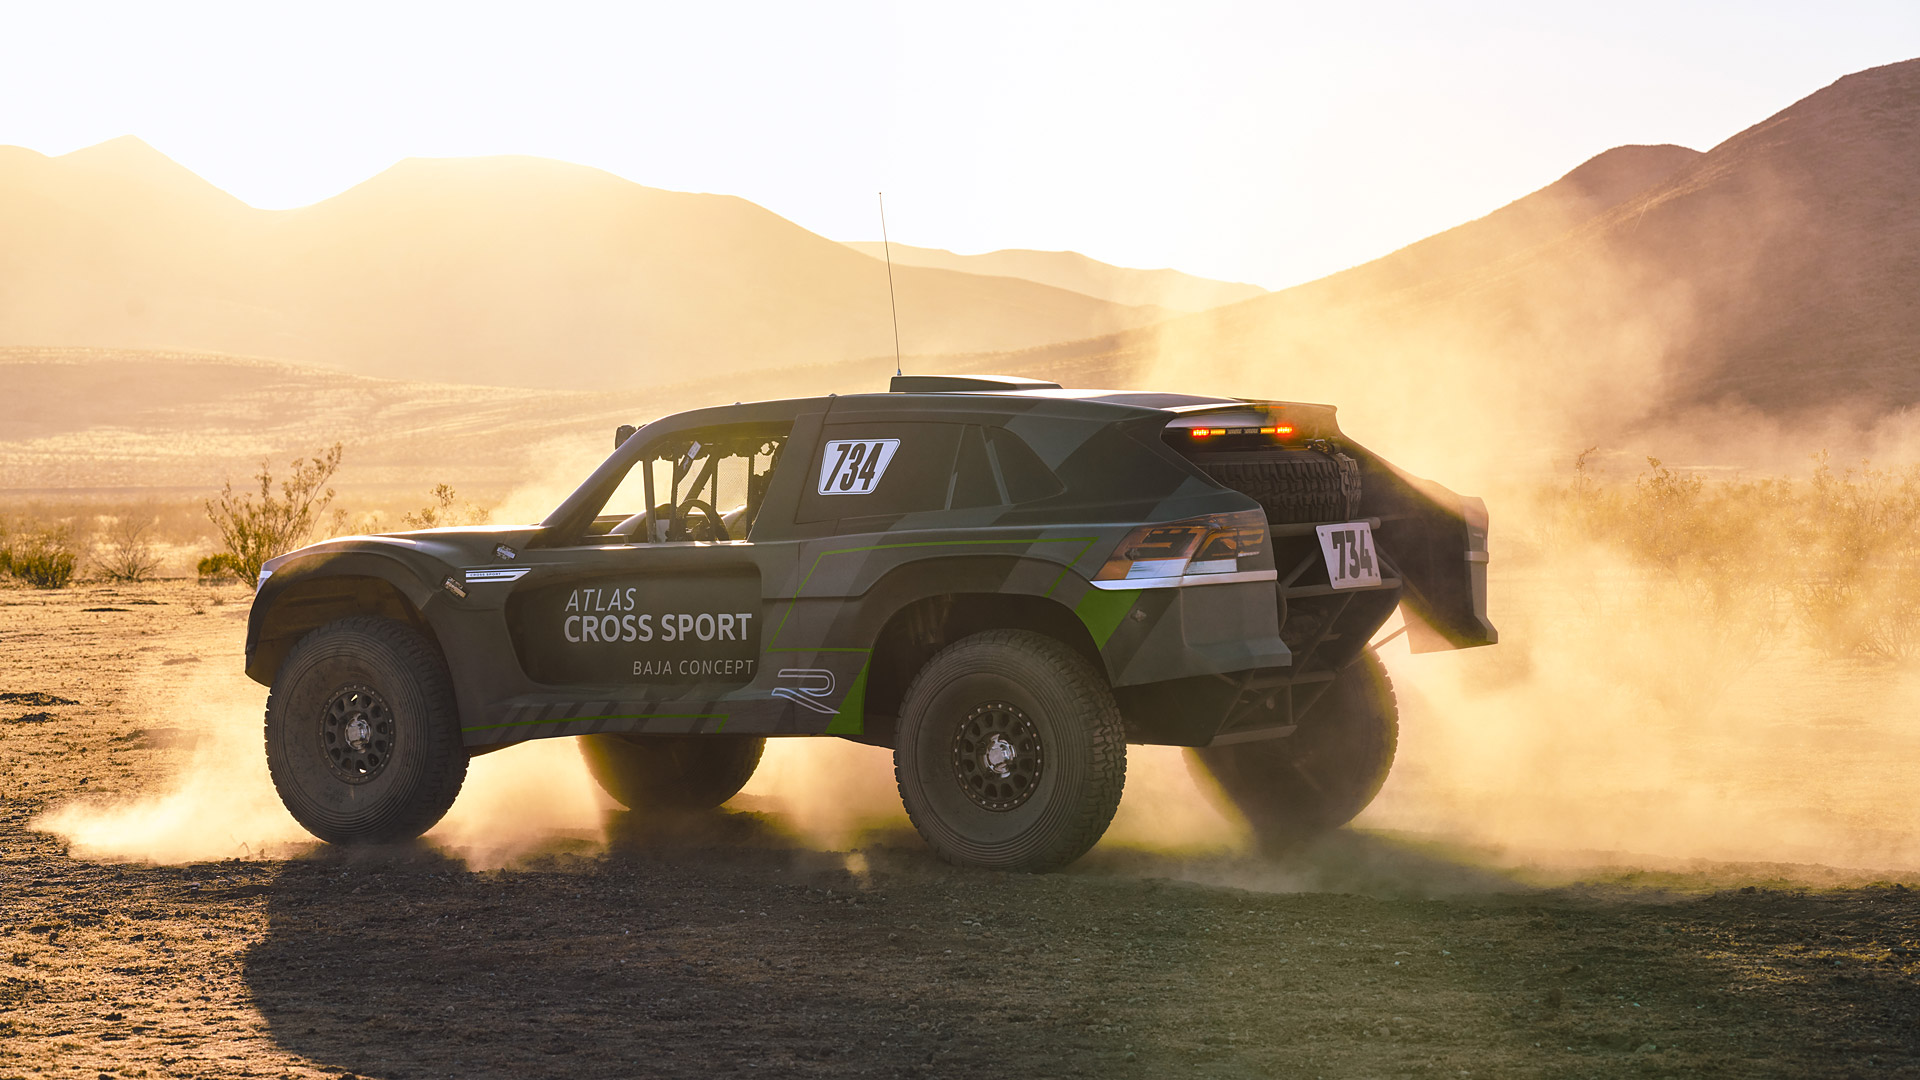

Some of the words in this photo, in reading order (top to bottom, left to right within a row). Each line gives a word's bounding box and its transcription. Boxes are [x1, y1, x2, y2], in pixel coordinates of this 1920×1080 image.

[823, 443, 884, 491] 734
[1331, 529, 1373, 579] 734
[564, 587, 637, 612] ATLAS
[564, 614, 653, 642] CROSS
[661, 613, 752, 642] SPORT
[633, 660, 672, 675] BAJA
[679, 660, 754, 675] CONCEPT
